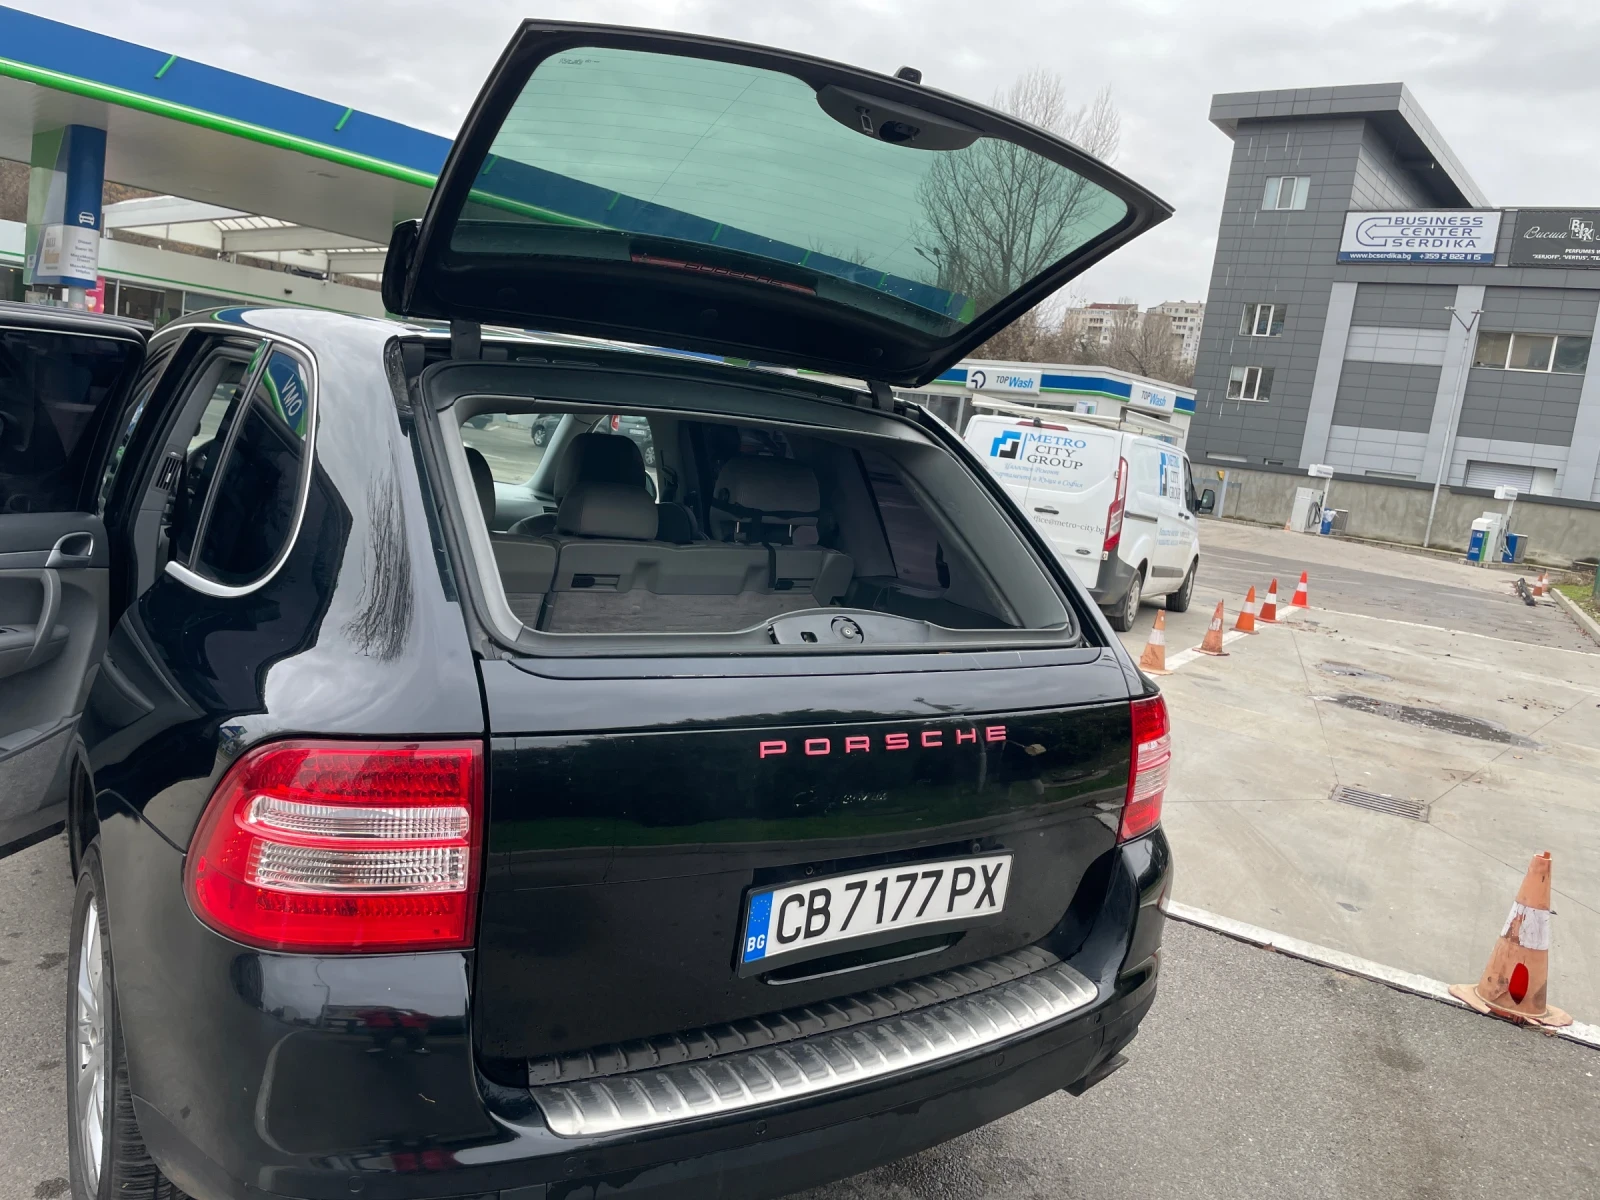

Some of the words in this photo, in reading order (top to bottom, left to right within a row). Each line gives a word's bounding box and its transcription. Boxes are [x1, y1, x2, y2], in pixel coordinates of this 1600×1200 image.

[1394, 216, 1484, 226] BUSINESS
[1400, 227, 1474, 237] CENTER
[1391, 238, 1477, 249] SERDIKA
[1350, 252, 1412, 261] www.bcserdika.bg
[1028, 433, 1087, 449] METRO
[1035, 445, 1077, 459] CITY
[1027, 454, 1084, 470] GROUP
[759, 725, 1008, 760] PORSCHE
[746, 934, 766, 953] BG
